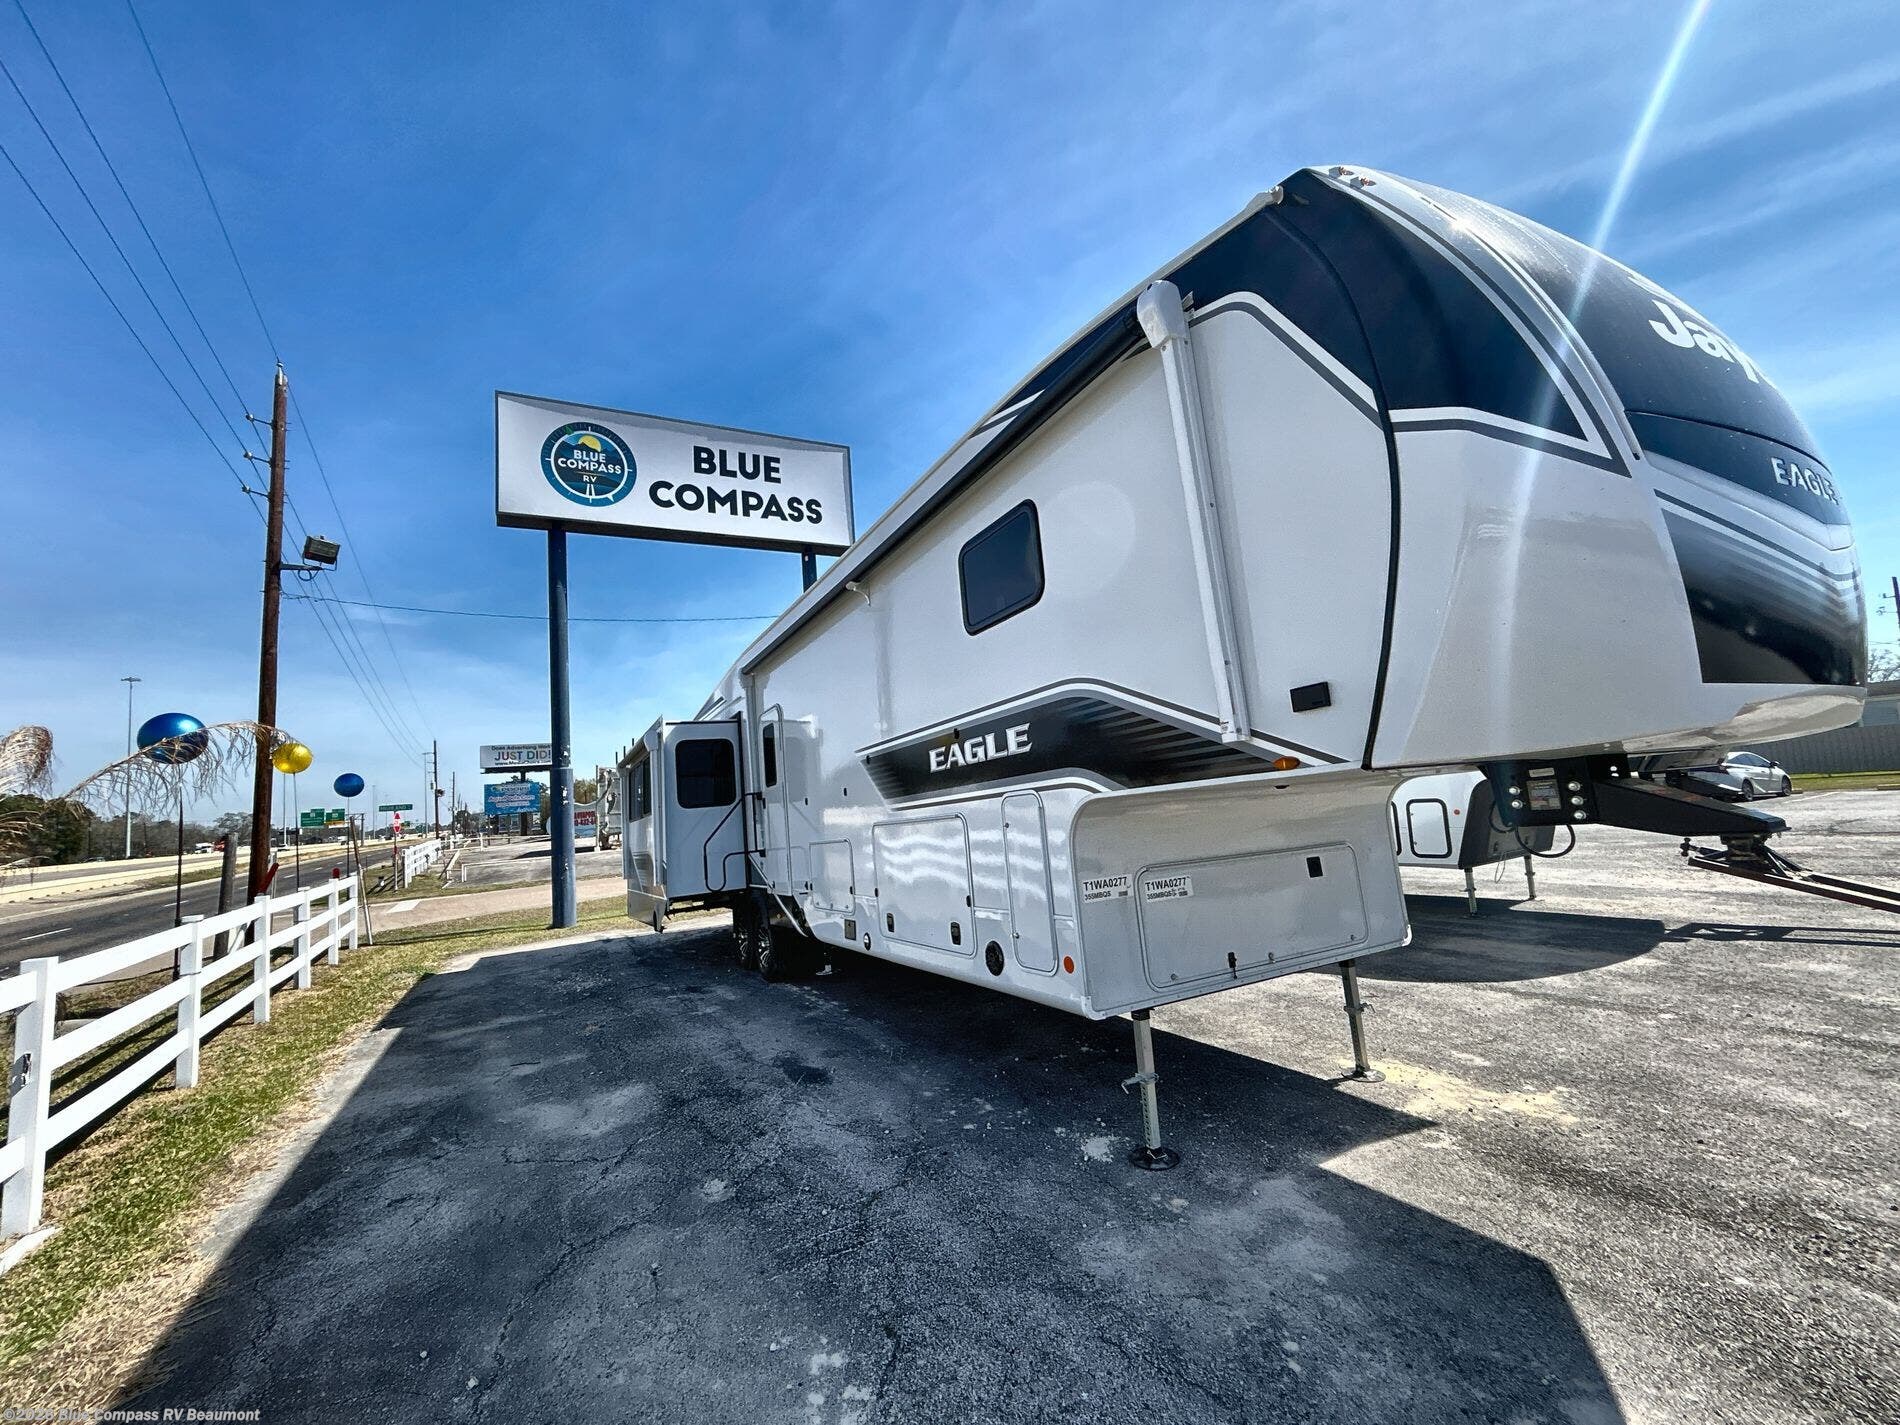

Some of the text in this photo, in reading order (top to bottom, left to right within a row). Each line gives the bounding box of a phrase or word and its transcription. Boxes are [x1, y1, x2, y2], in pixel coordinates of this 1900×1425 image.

[573, 449, 607, 463] BLUE
[557, 457, 622, 475] COMPASS
[693, 445, 782, 485] BLUE
[582, 474, 597, 483] RV
[1770, 456, 1839, 506] EAGLE
[649, 480, 823, 525] COMPASS
[495, 749, 551, 761] JUST DID!
[928, 722, 1033, 774] EAGLE
[1083, 876, 1127, 891] T1WA0277
[1145, 877, 1186, 891] T1WA0277
